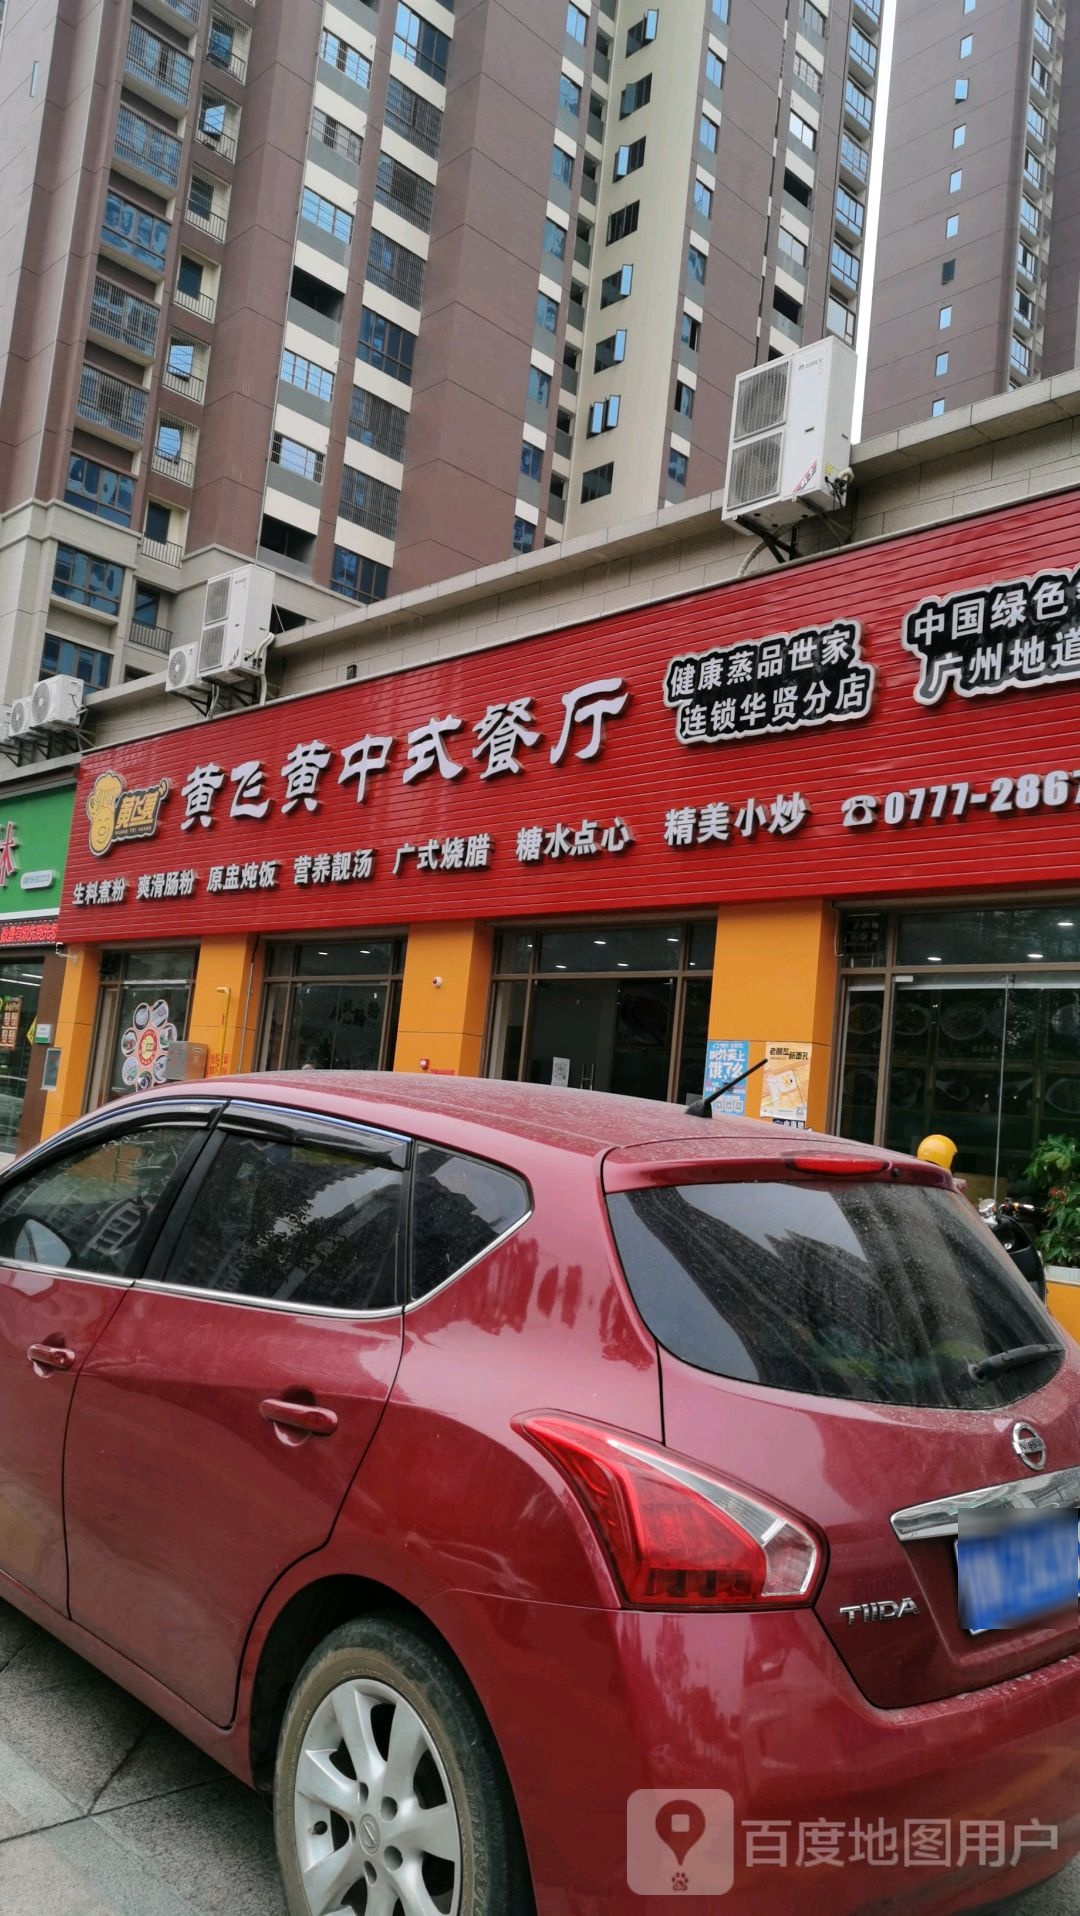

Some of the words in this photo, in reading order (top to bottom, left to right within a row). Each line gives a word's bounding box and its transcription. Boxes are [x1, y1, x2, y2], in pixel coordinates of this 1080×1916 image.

[914, 580, 1080, 646] 中国绿色
[670, 629, 851, 697] 健康蒸品世家
[932, 627, 1080, 696] 广州地道
[681, 672, 866, 737] 连锁华贤分店
[180, 677, 630, 831] 黄飞黄中式餐厅
[72, 879, 126, 905] 生料煮粉
[136, 869, 195, 900] 爽滑肠粉
[207, 860, 278, 892] 原盅炖饭
[293, 848, 374, 885] 营养靓汤
[392, 833, 491, 875] 广式烧腊
[515, 817, 632, 862] 糖水点心
[664, 792, 810, 846] 精美小炒
[839, 1597, 920, 1625] TIIDA
